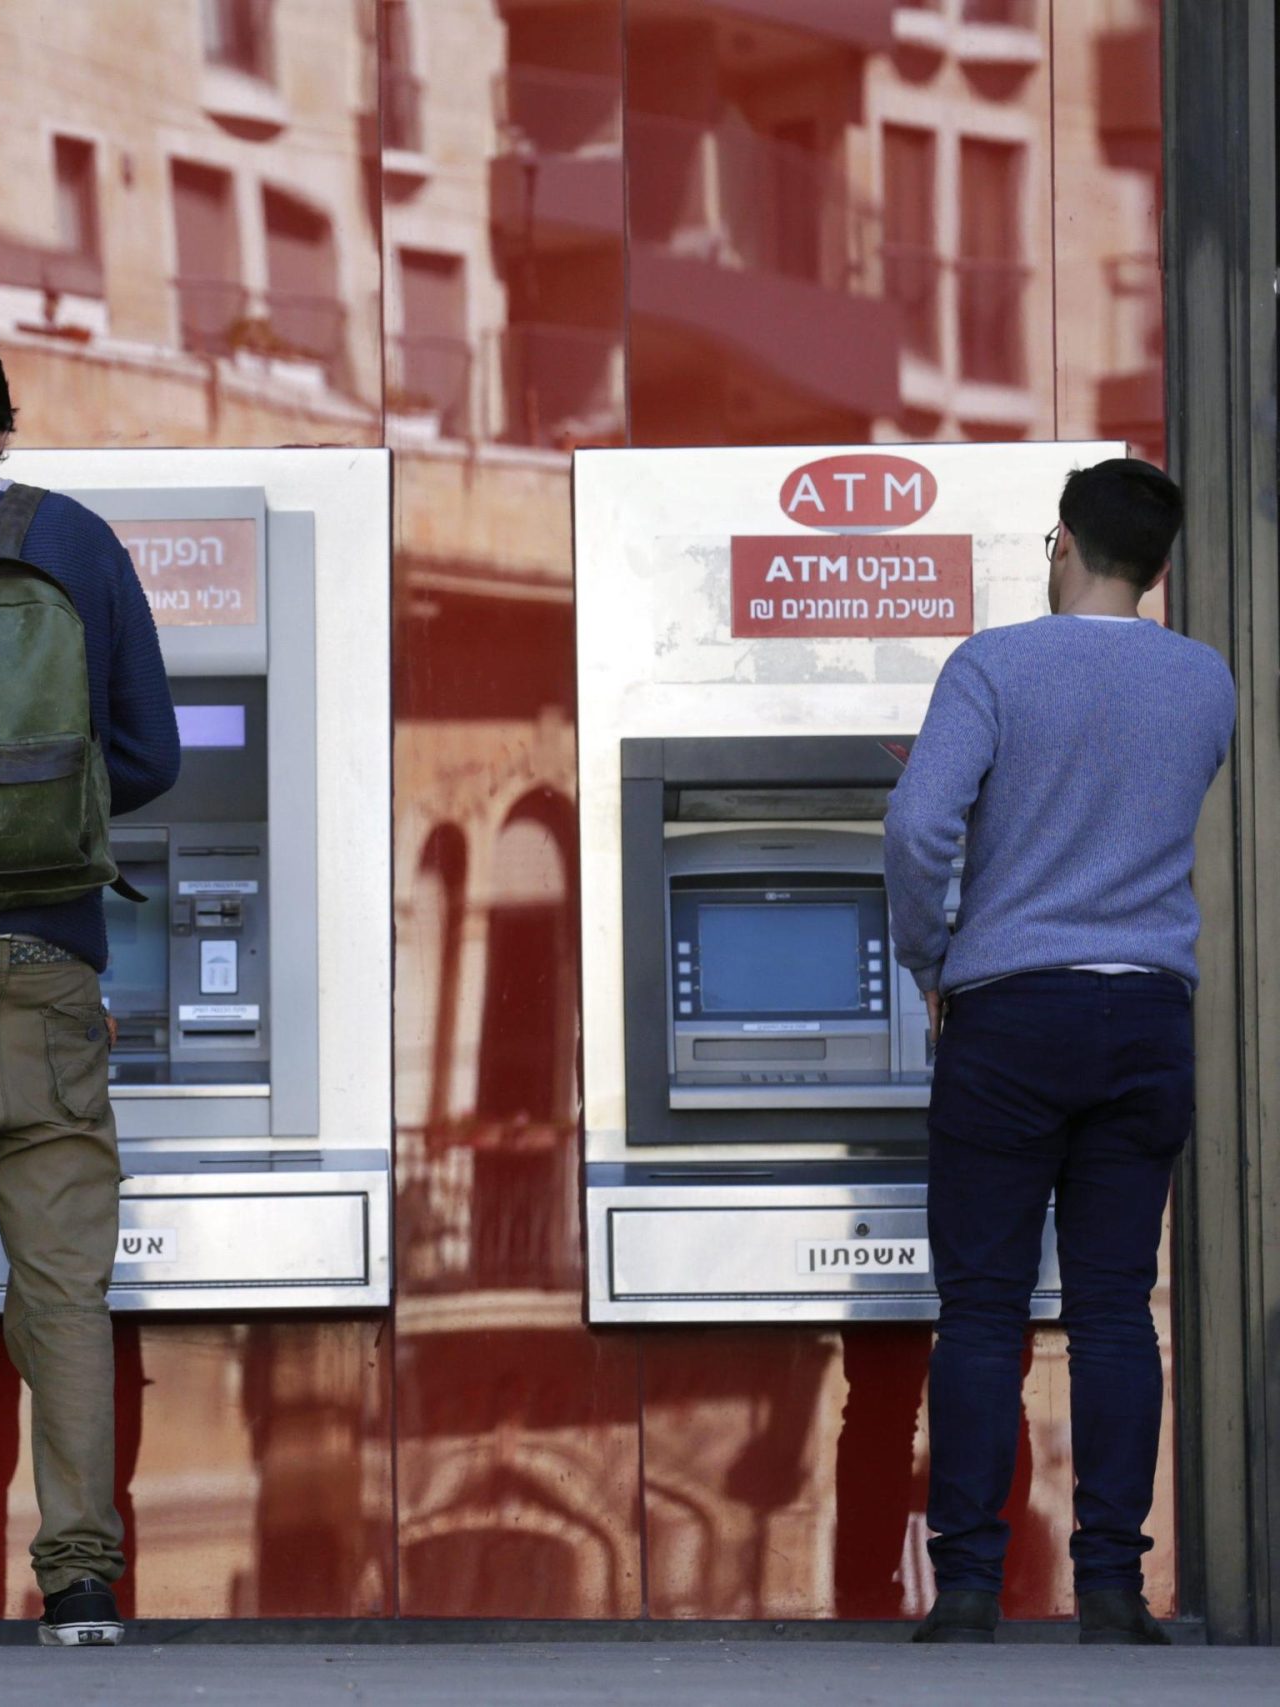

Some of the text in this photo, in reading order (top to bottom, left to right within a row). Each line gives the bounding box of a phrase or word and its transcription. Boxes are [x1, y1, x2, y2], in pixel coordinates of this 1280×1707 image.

[787, 472, 922, 512] ATM
[122, 537, 224, 575] הפקד
[765, 555, 937, 590] בנקט ATM
[196, 585, 242, 610] גילוי
[781, 598, 869, 620] מזומנים
[875, 598, 955, 619] משיכת
[122, 1237, 164, 1255] אש
[809, 1247, 916, 1272] אשפתון
